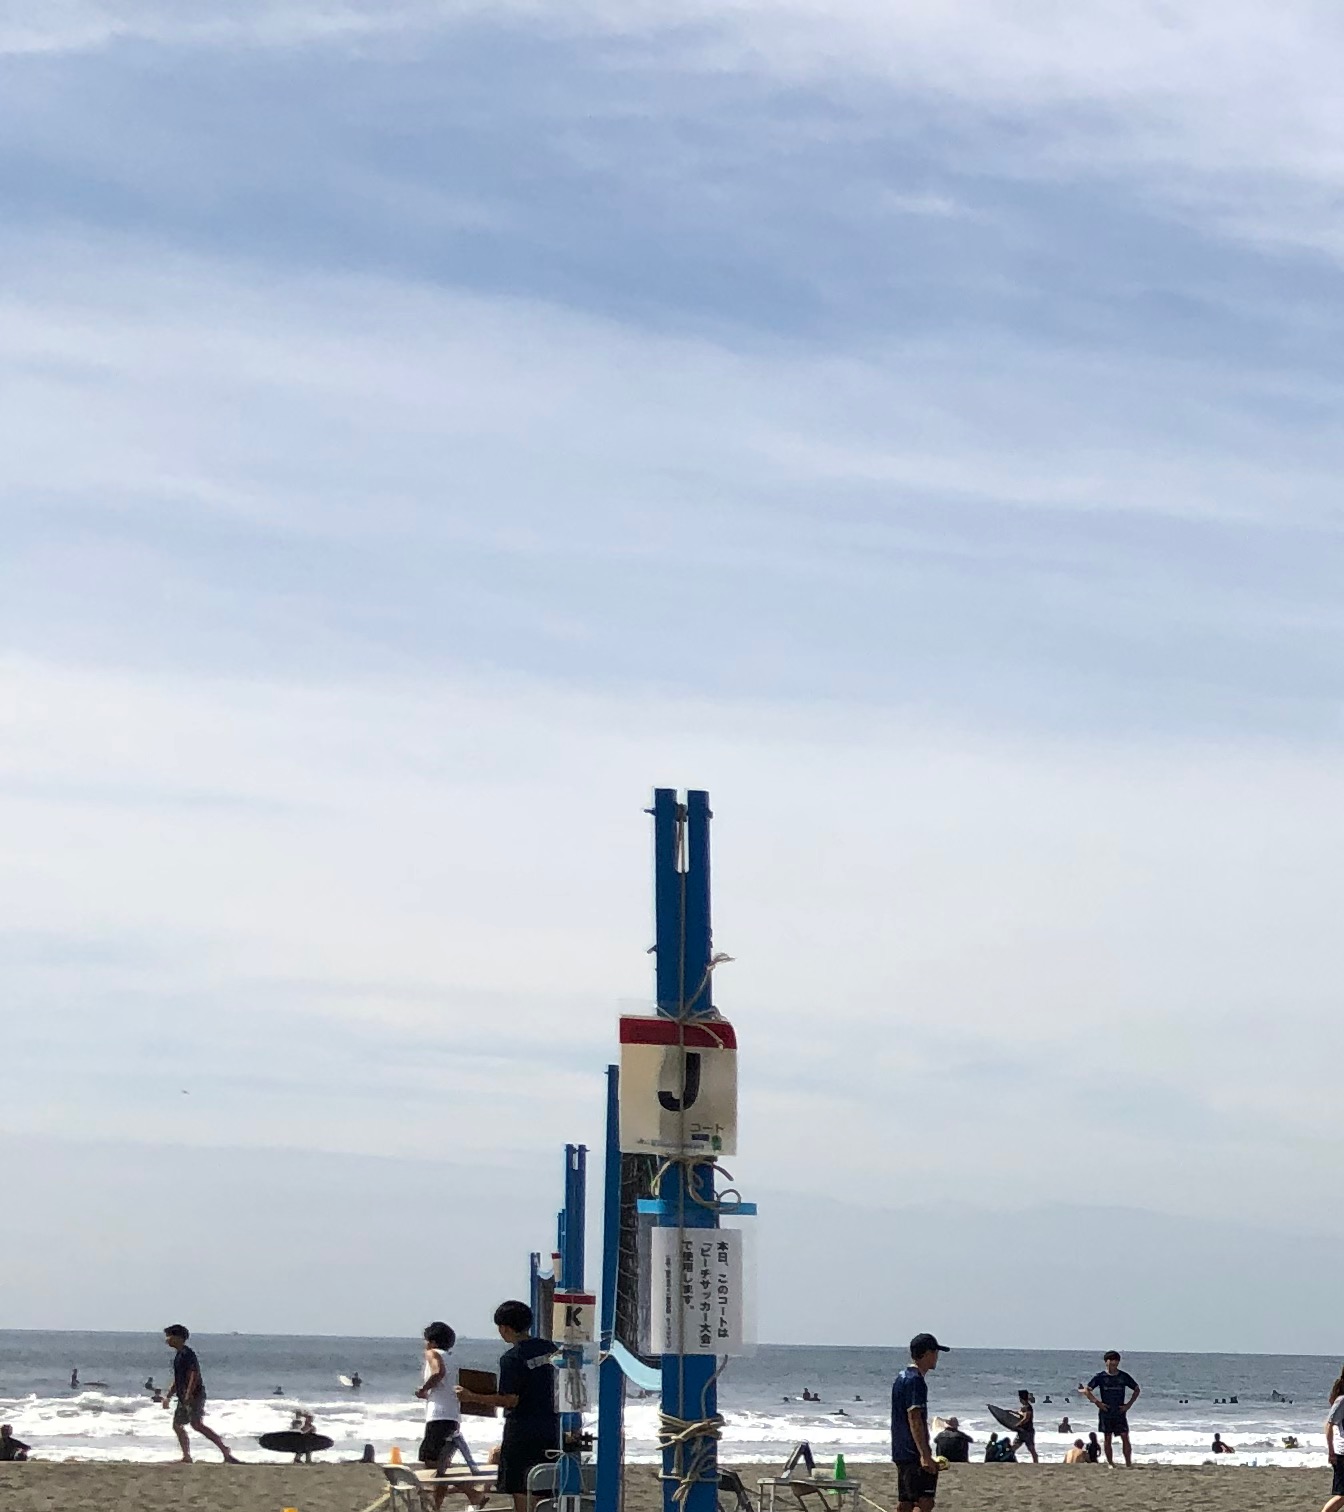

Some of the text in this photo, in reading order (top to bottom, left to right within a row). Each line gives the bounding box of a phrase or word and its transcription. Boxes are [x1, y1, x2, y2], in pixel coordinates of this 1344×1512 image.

[657, 1051, 701, 1112] J
[690, 1123, 725, 1133] コート
[565, 1305, 583, 1327] K
